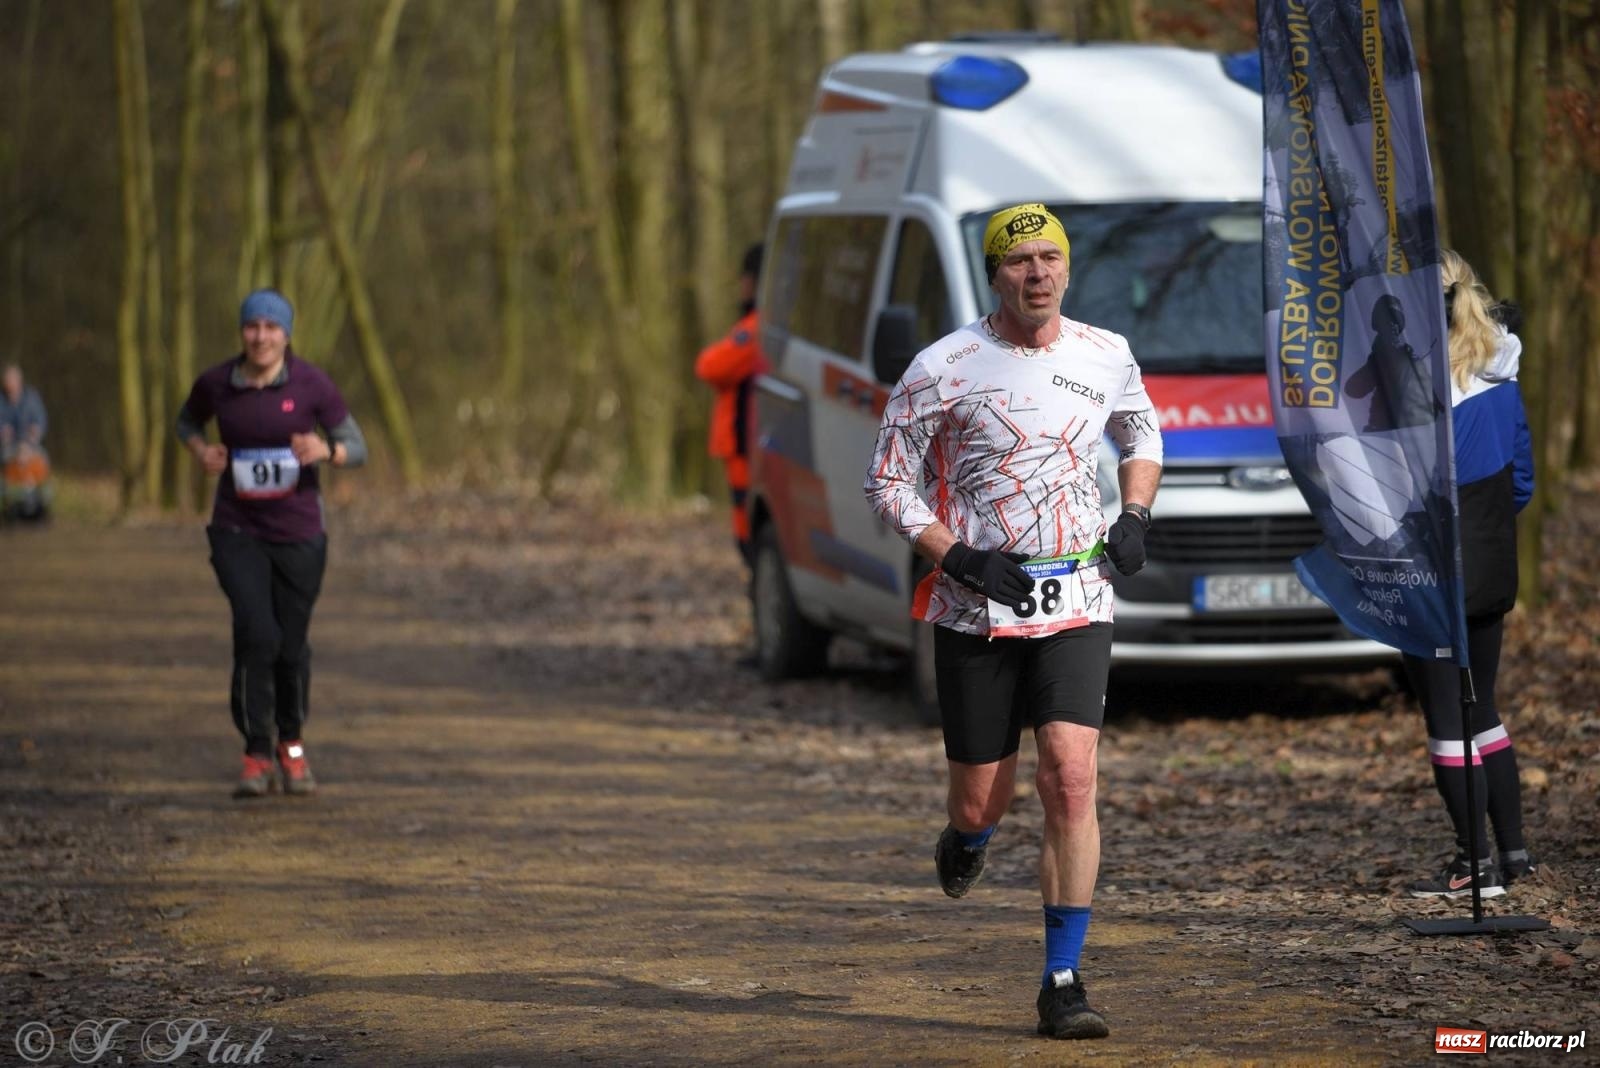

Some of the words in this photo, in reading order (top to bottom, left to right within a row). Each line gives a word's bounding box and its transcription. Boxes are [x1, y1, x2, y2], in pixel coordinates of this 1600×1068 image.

[946, 343, 980, 365] deep
[1052, 374, 1106, 405] DYCZUŚ
[252, 462, 281, 486] 91
[1026, 561, 1069, 573] TWARDZIELA
